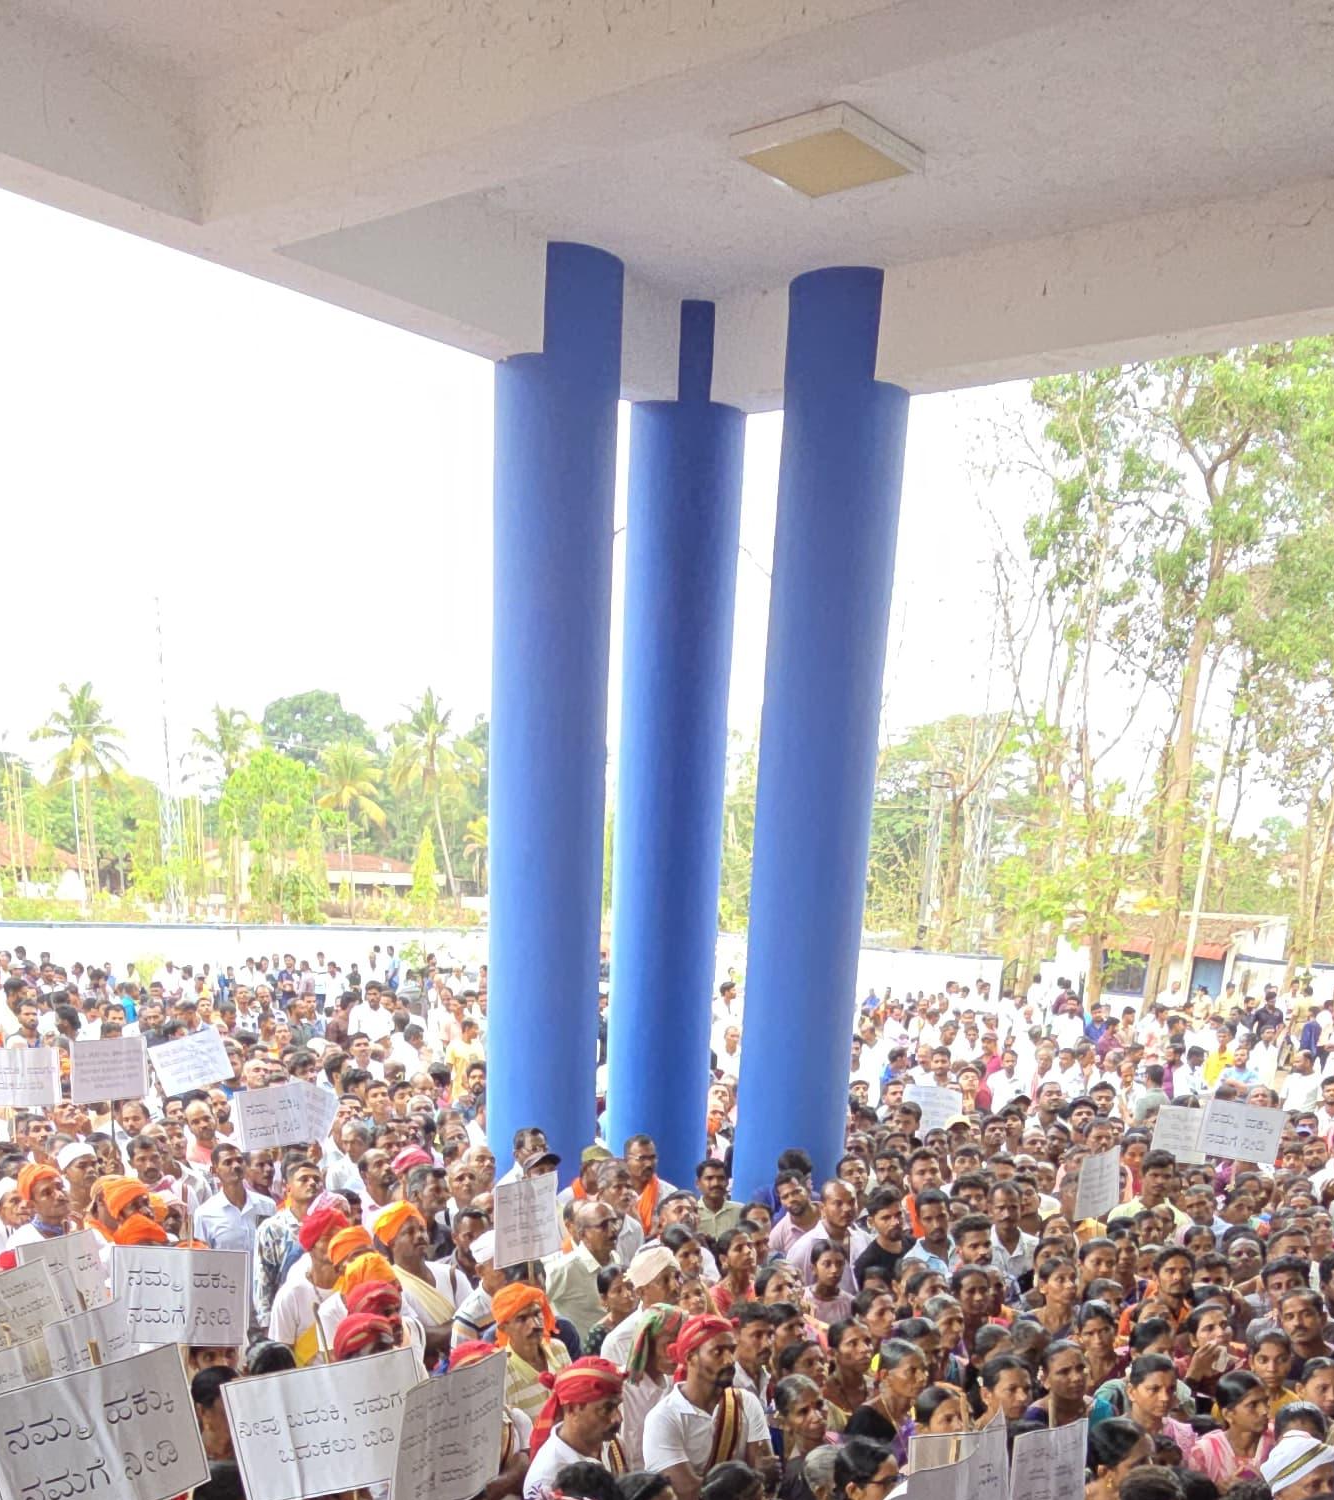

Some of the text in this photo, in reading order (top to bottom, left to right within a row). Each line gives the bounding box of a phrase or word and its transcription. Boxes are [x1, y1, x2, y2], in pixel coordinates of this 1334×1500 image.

[126, 1267, 238, 1296] ನಮ್ಮ ಹಕ್ಕು
[128, 1303, 232, 1331] ನಮಗೆ ನೀಡಿ
[4, 1386, 177, 1456] ನಮ್ಮ ಹಕ್ಕು
[238, 1415, 281, 1440] ನೀವು
[287, 1404, 348, 1430] ಬದುಕಿ,
[123, 1437, 179, 1482] ನೀಡಿ
[278, 1424, 395, 1464] ಬದುಕಲು ಬಿಡಿ
